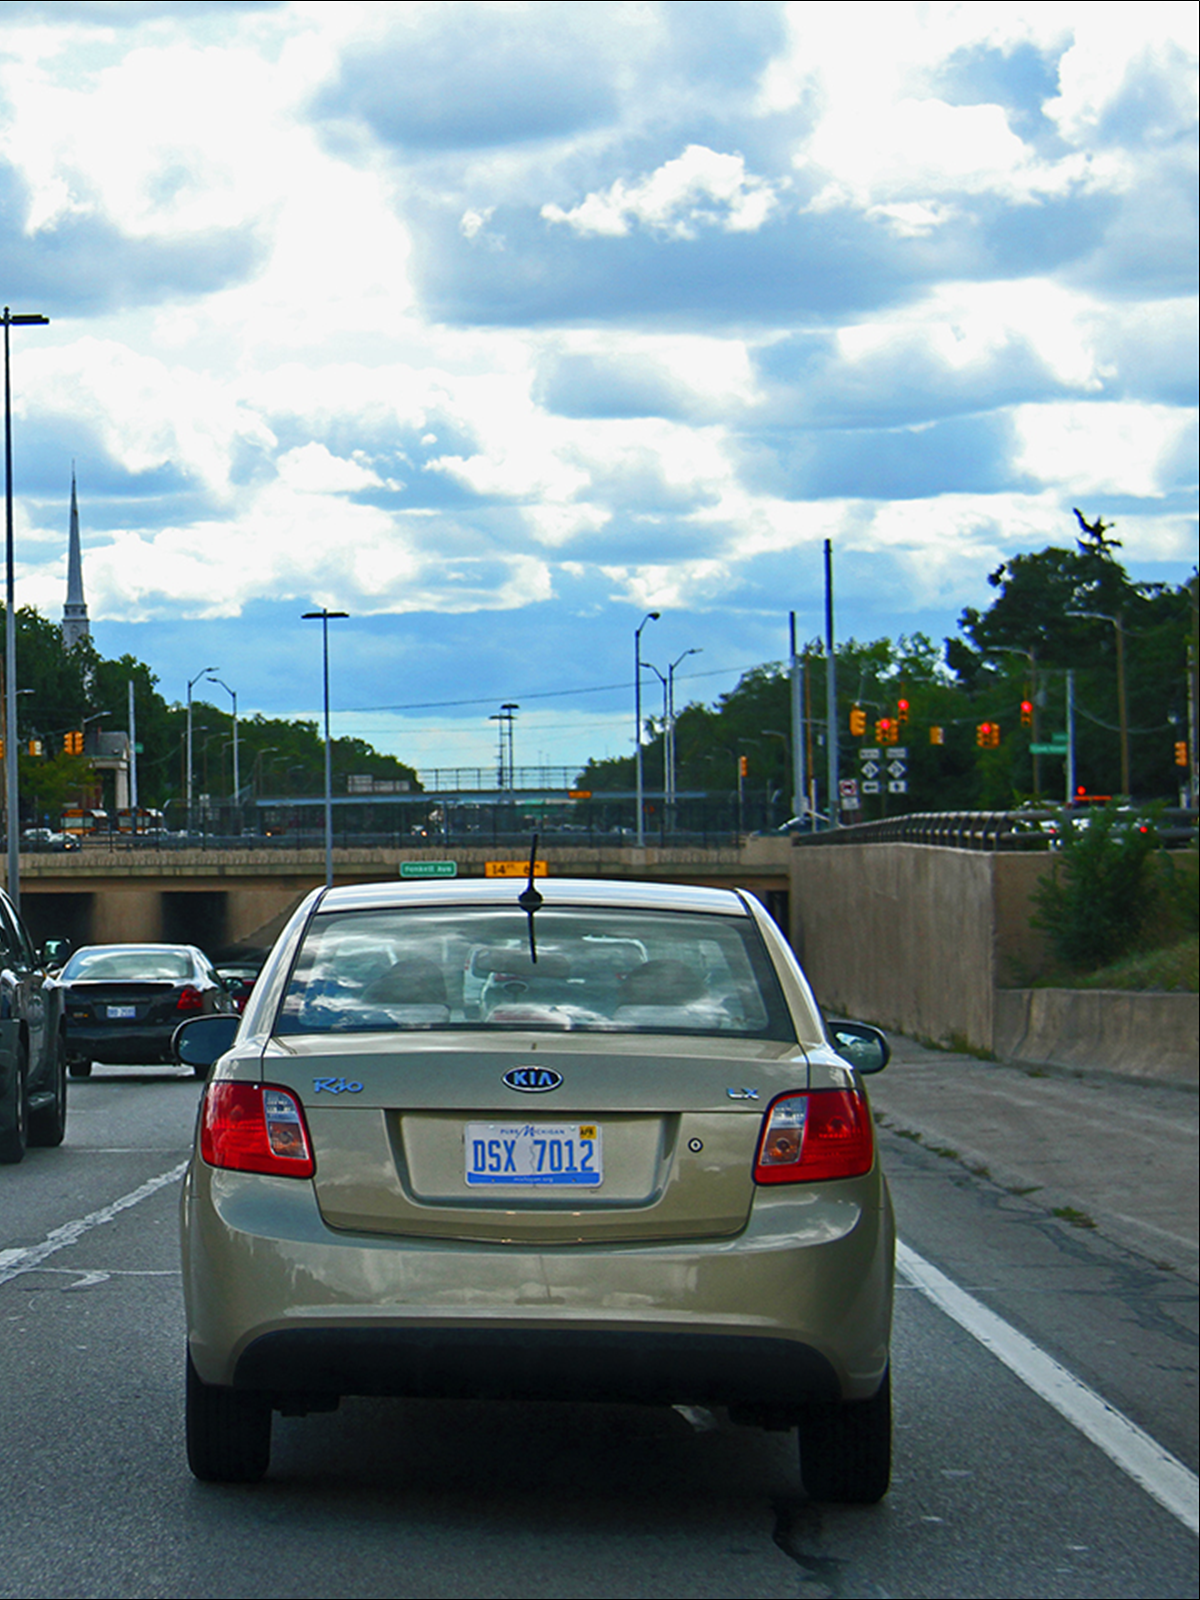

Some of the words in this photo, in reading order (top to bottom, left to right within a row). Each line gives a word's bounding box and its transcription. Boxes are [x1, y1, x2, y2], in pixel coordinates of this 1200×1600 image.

[492, 864, 506, 875] 14
[313, 1077, 363, 1094] Rio
[513, 1071, 552, 1086] KIA
[727, 1087, 760, 1100] LX
[472, 1139, 517, 1172] DSX
[533, 1139, 594, 1172] 7012
